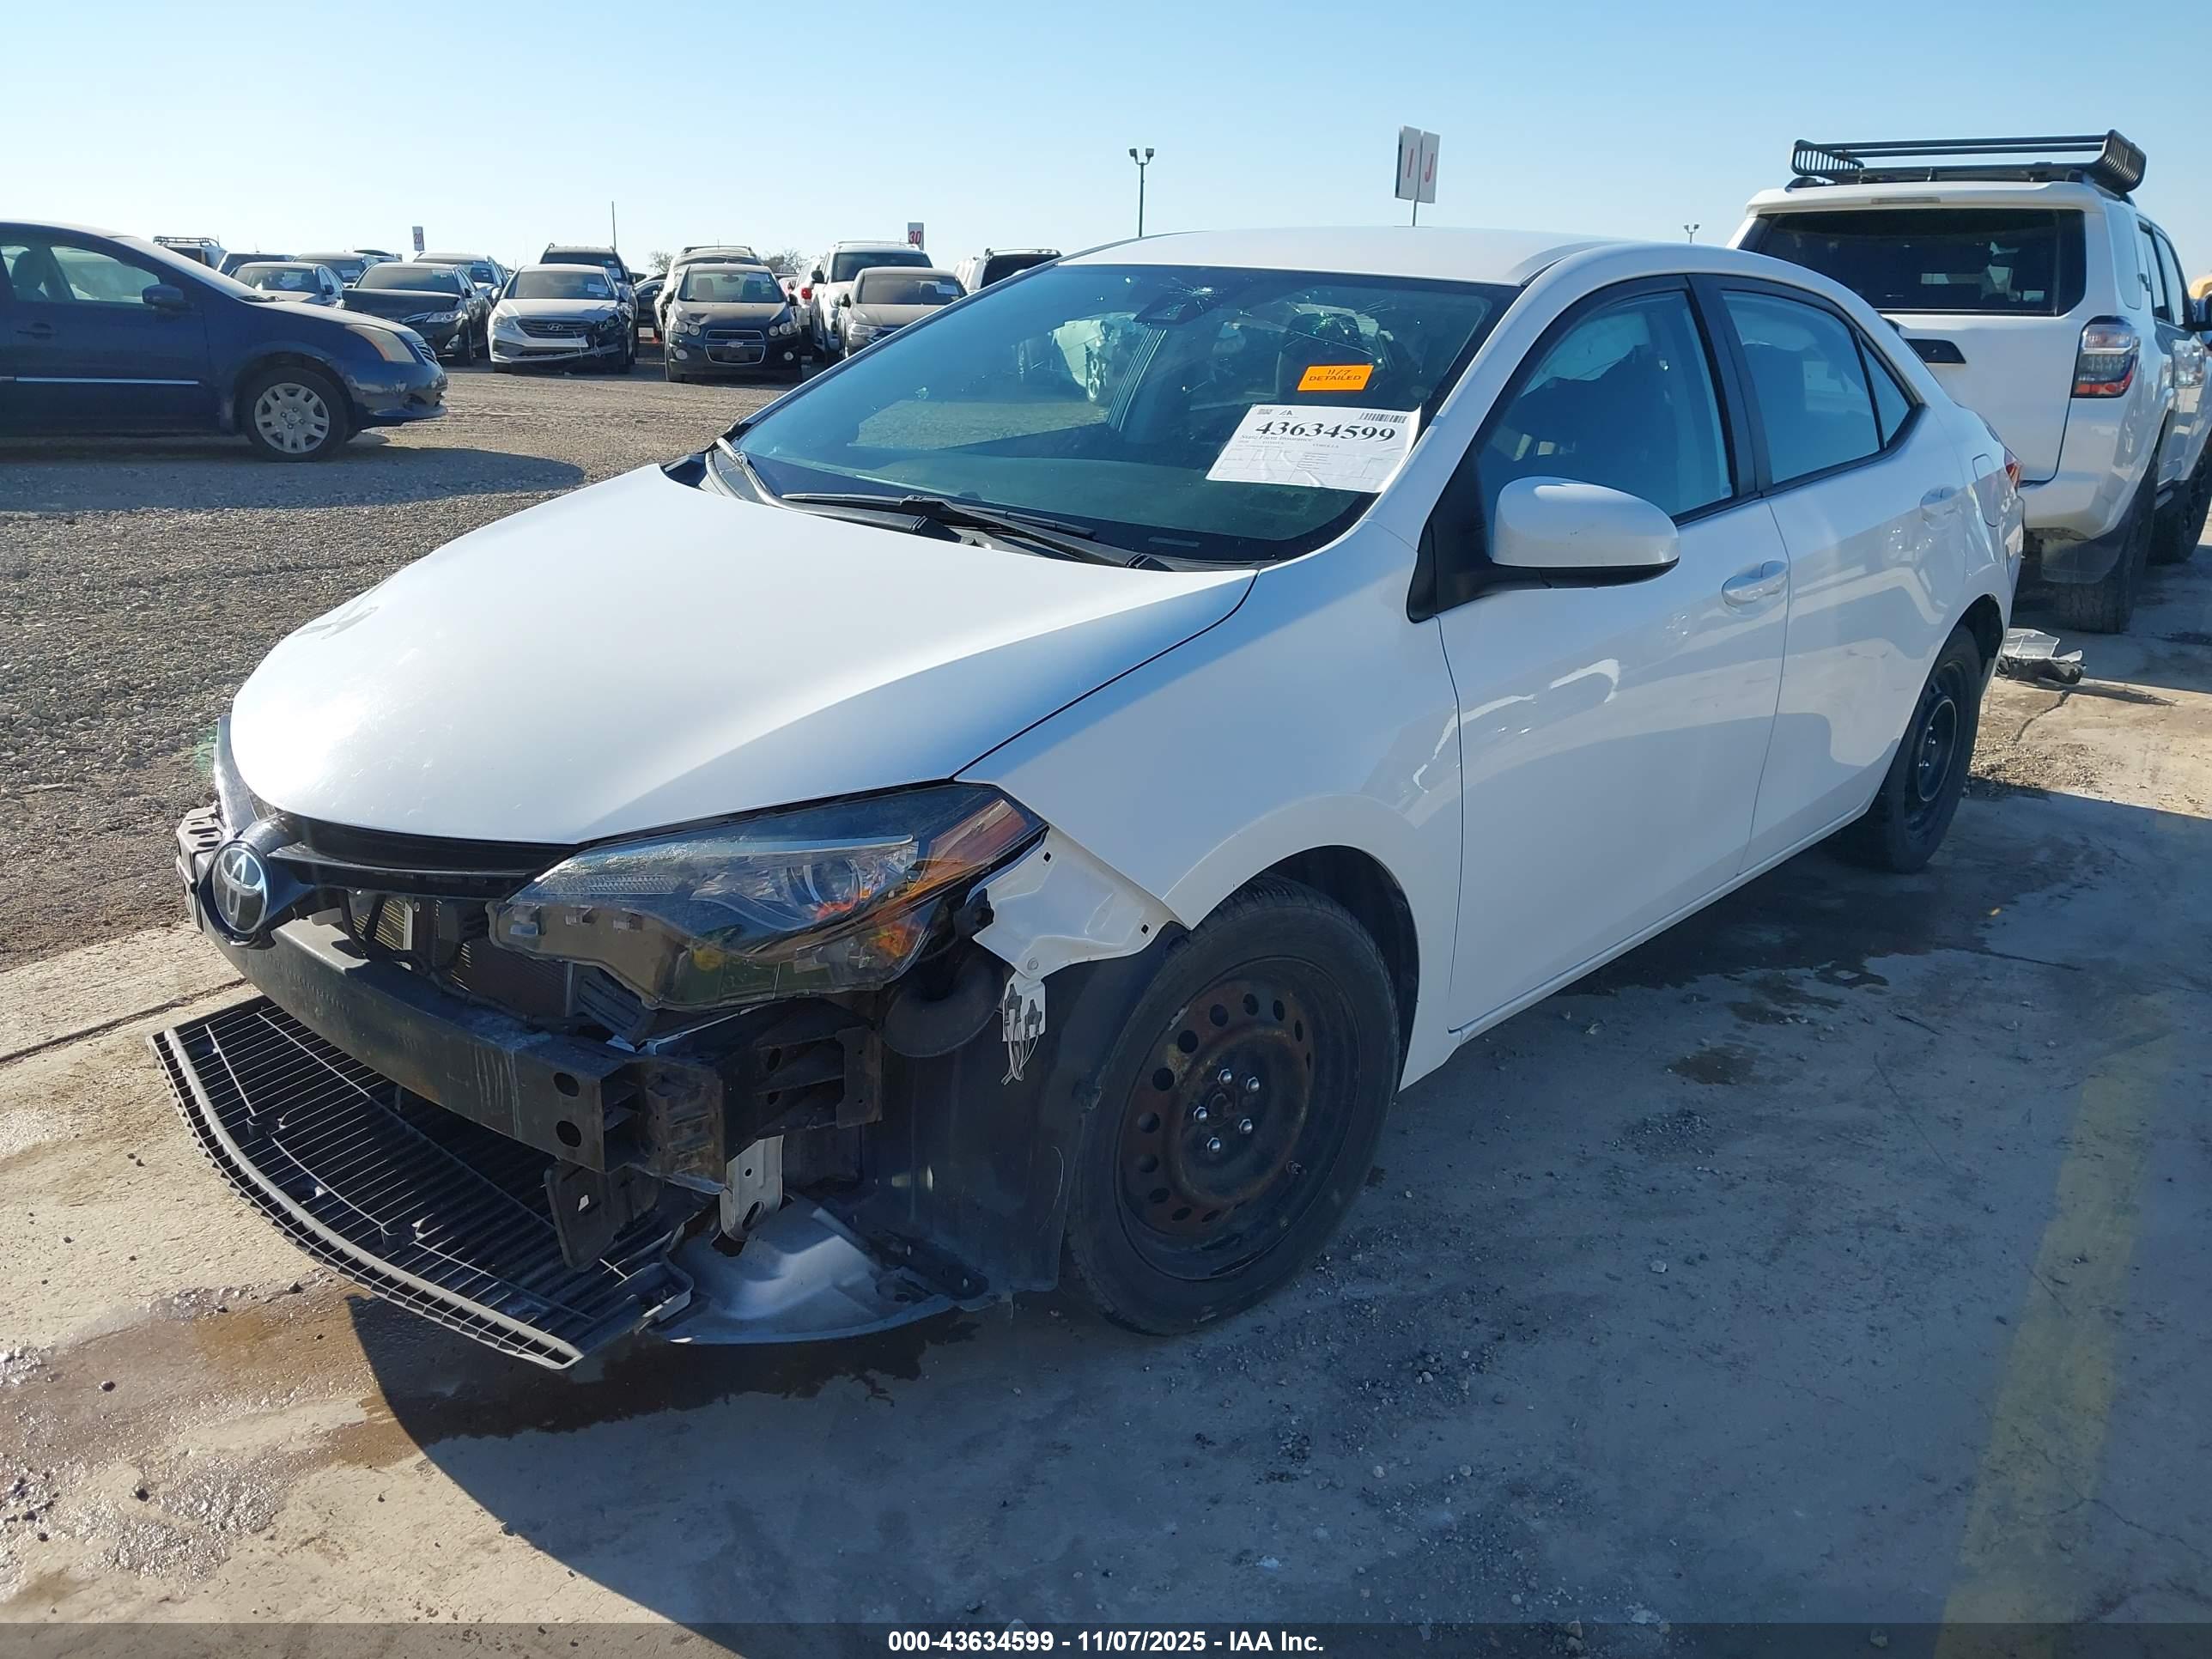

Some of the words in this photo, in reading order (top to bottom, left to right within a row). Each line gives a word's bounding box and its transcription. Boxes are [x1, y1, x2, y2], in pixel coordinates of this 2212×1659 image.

[1424, 153, 1434, 183] J
[414, 233, 422, 244] 20
[908, 230, 921, 244] 30
[1255, 420, 1396, 442] 43634599
